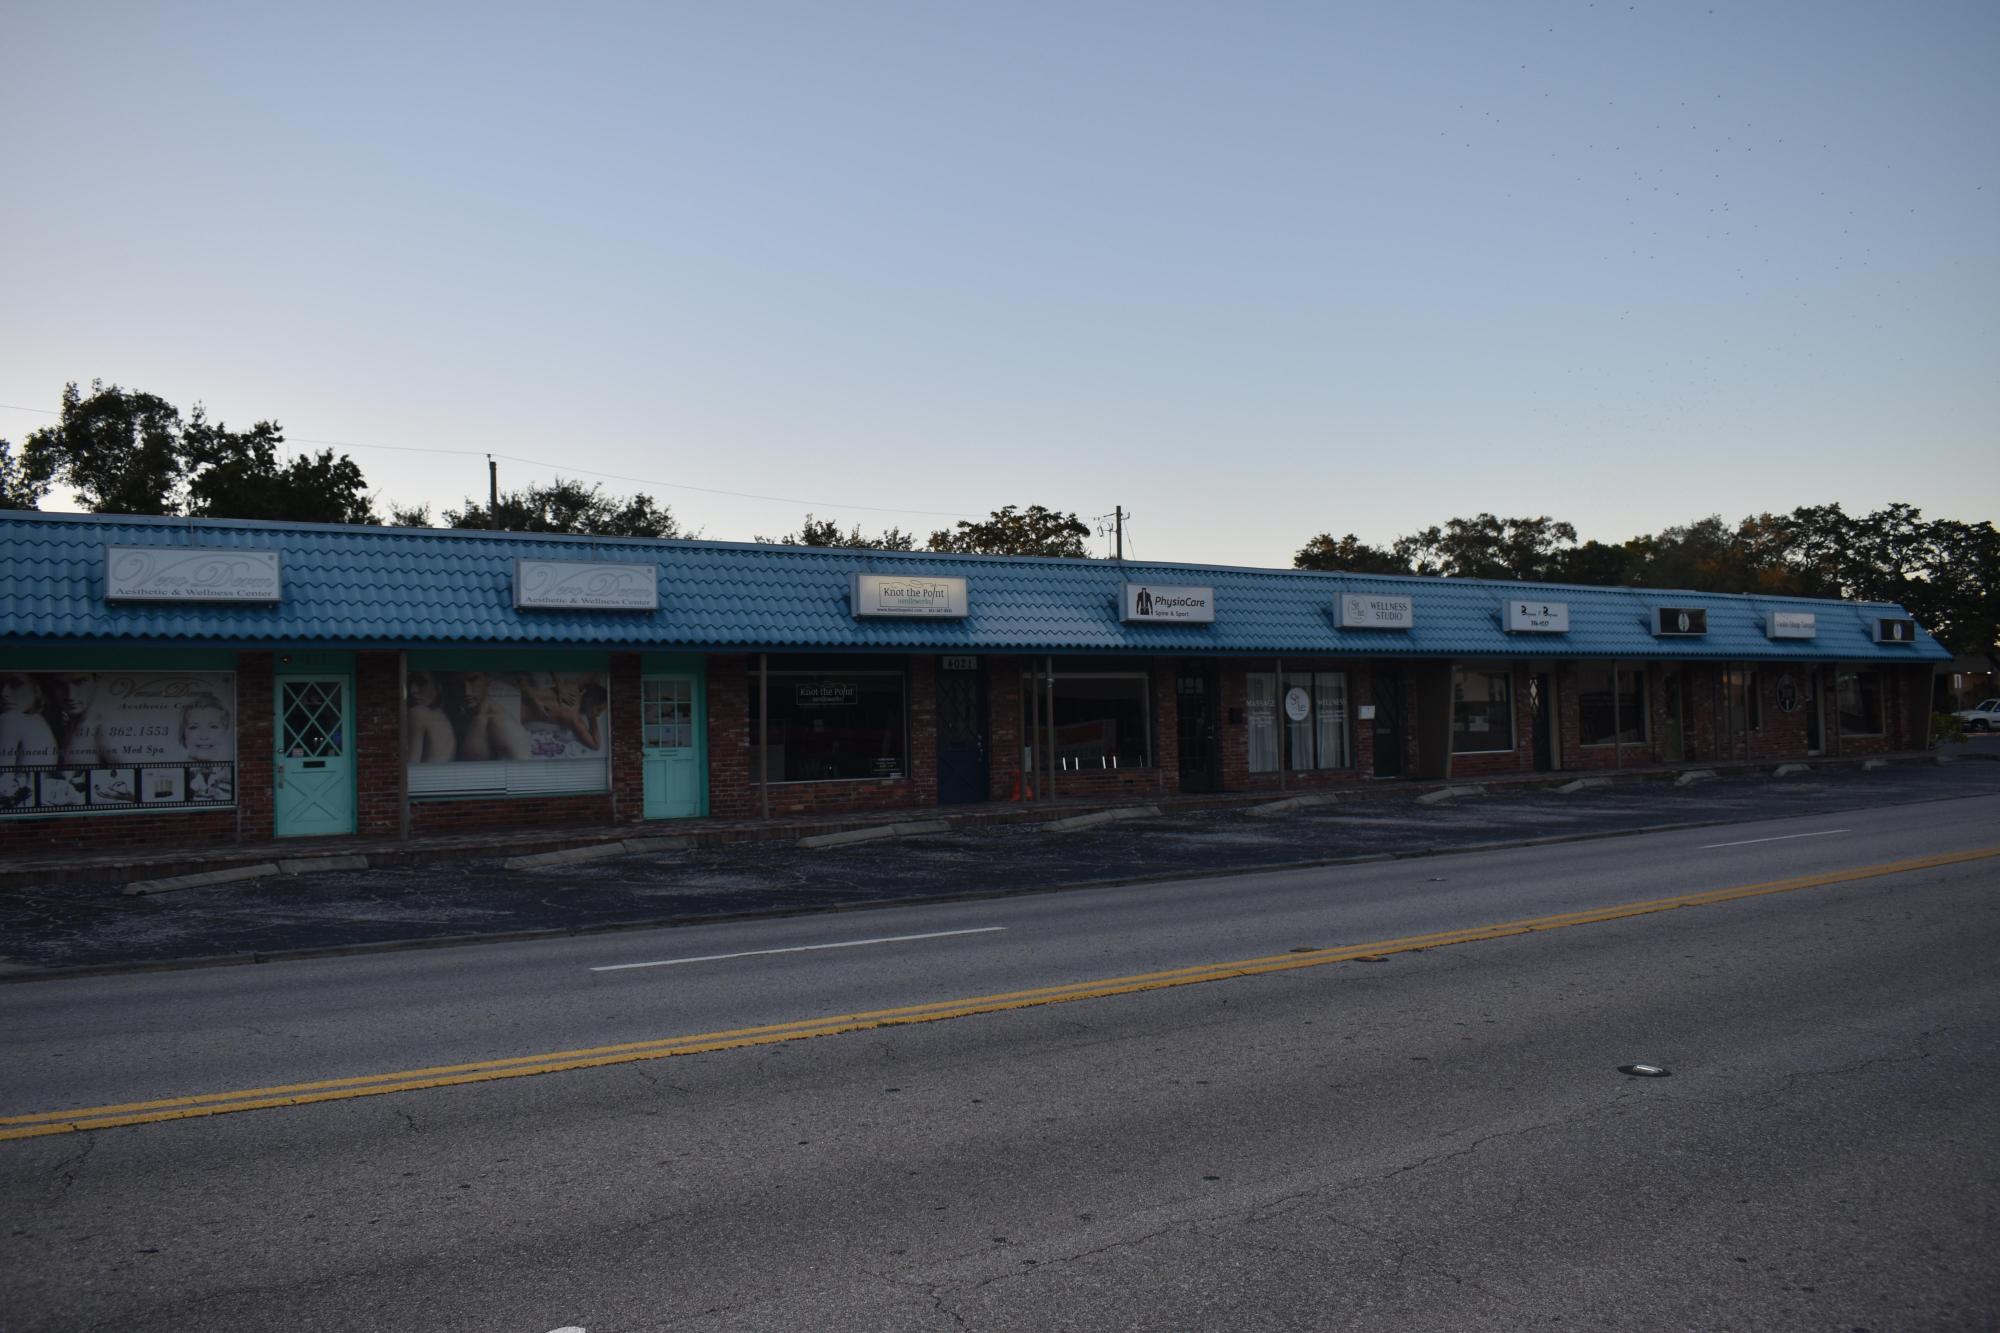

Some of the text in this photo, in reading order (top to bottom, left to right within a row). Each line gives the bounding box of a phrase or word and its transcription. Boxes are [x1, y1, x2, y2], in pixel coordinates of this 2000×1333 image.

[117, 588, 167, 596] Aesthetic
[185, 589, 233, 597] Wellness
[884, 587, 904, 597] Knot
[907, 588, 920, 598] the
[1155, 595, 1206, 608] PhysioCare
[1370, 601, 1408, 611] WELLNESS
[1376, 611, 1403, 621] STUDIO
[800, 687, 818, 696] Knot
[820, 688, 832, 696] the
[109, 726, 169, 737] 862.1553
[122, 745, 143, 755] Med
[146, 744, 165, 756] Spa
